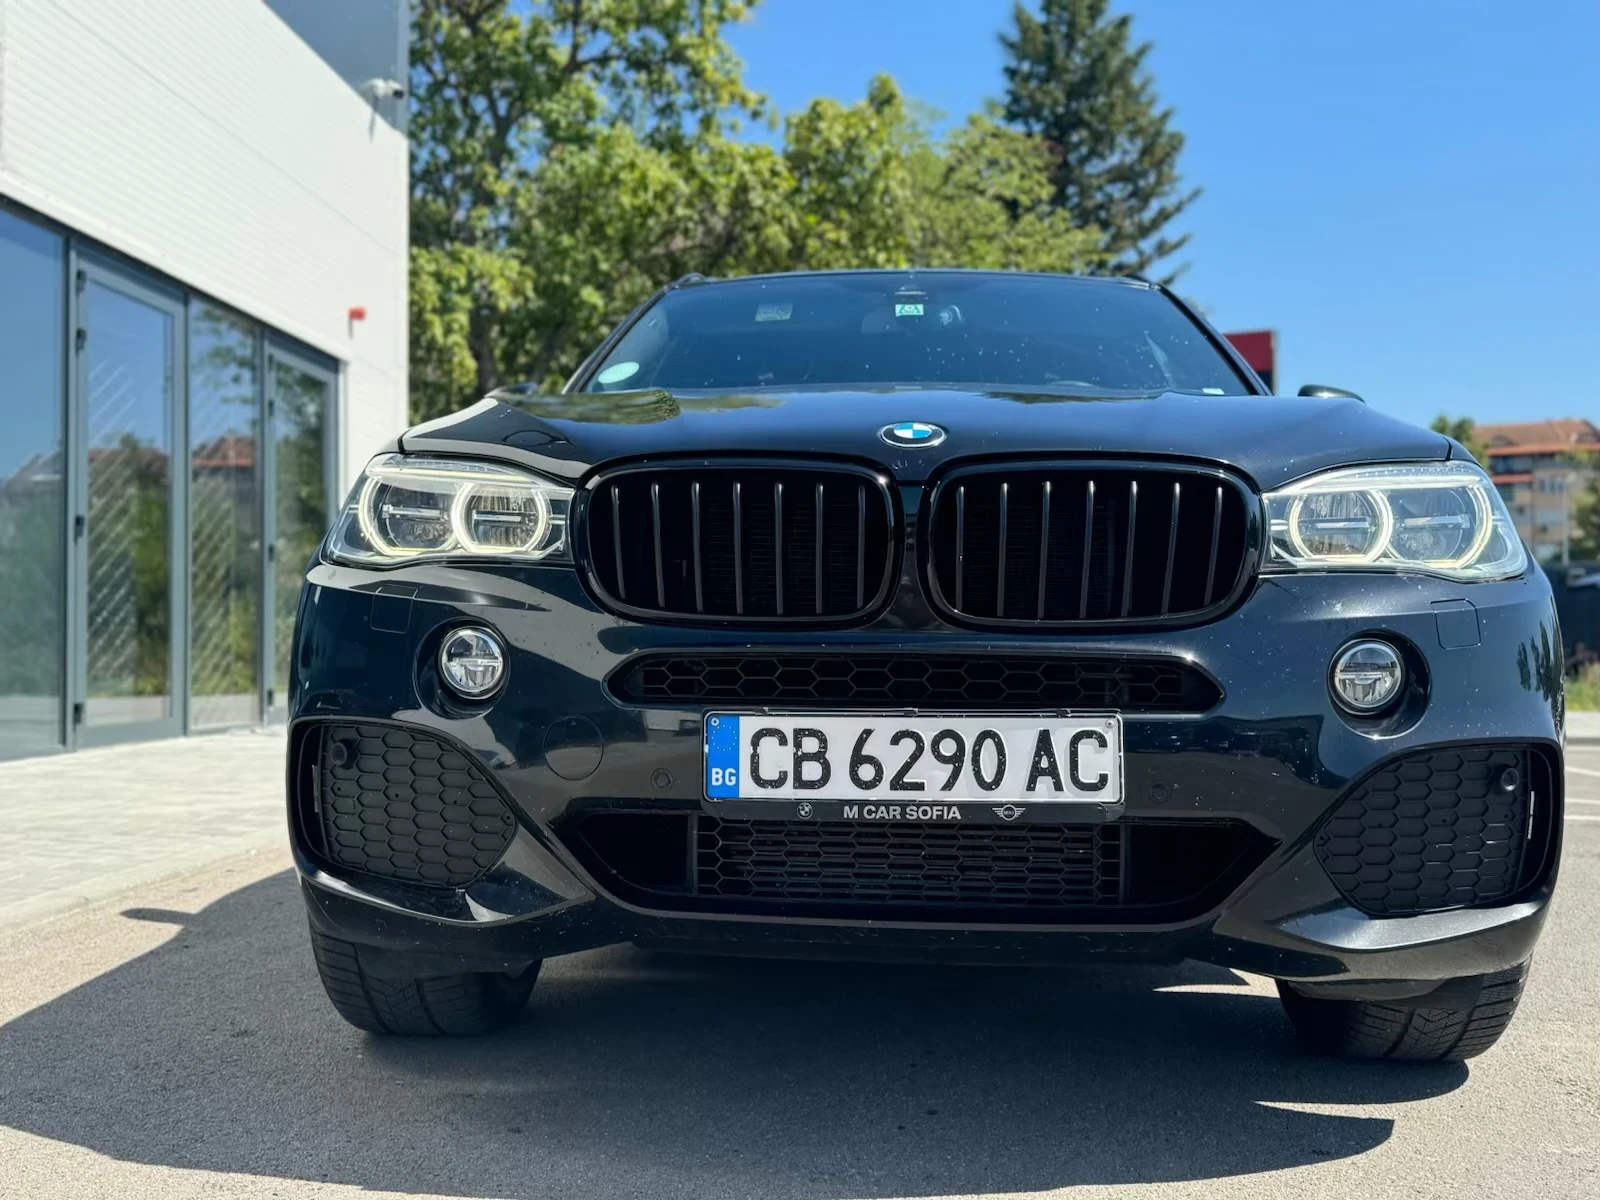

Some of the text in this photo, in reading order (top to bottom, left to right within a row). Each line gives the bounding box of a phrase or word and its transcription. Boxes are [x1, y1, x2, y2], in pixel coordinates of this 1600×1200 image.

[750, 727, 1109, 792] CB 6290 AC
[711, 767, 737, 786] BG
[843, 805, 962, 820] M CAR SOFIA
